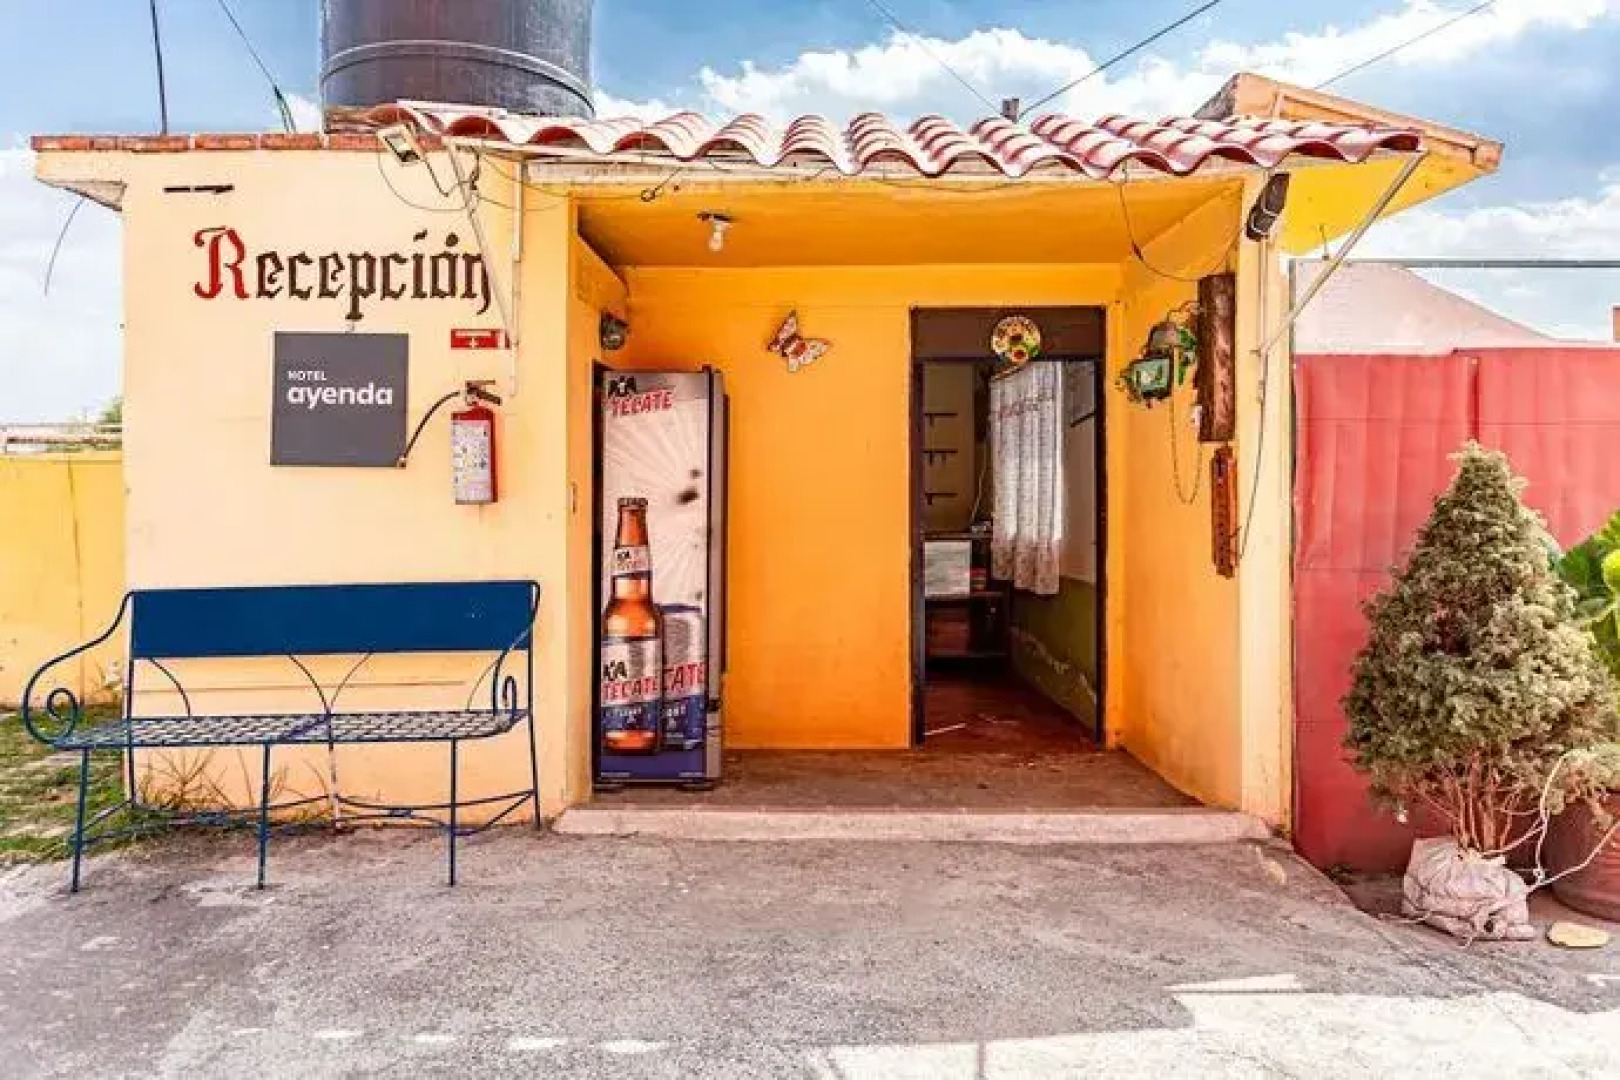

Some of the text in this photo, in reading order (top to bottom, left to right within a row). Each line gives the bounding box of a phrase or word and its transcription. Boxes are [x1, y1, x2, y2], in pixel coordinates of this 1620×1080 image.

[193, 225, 491, 320] Recepción
[288, 370, 327, 381] HOTEL
[287, 382, 393, 409] ayenda
[611, 390, 672, 417] TECATE
[602, 677, 658, 700] TECATE
